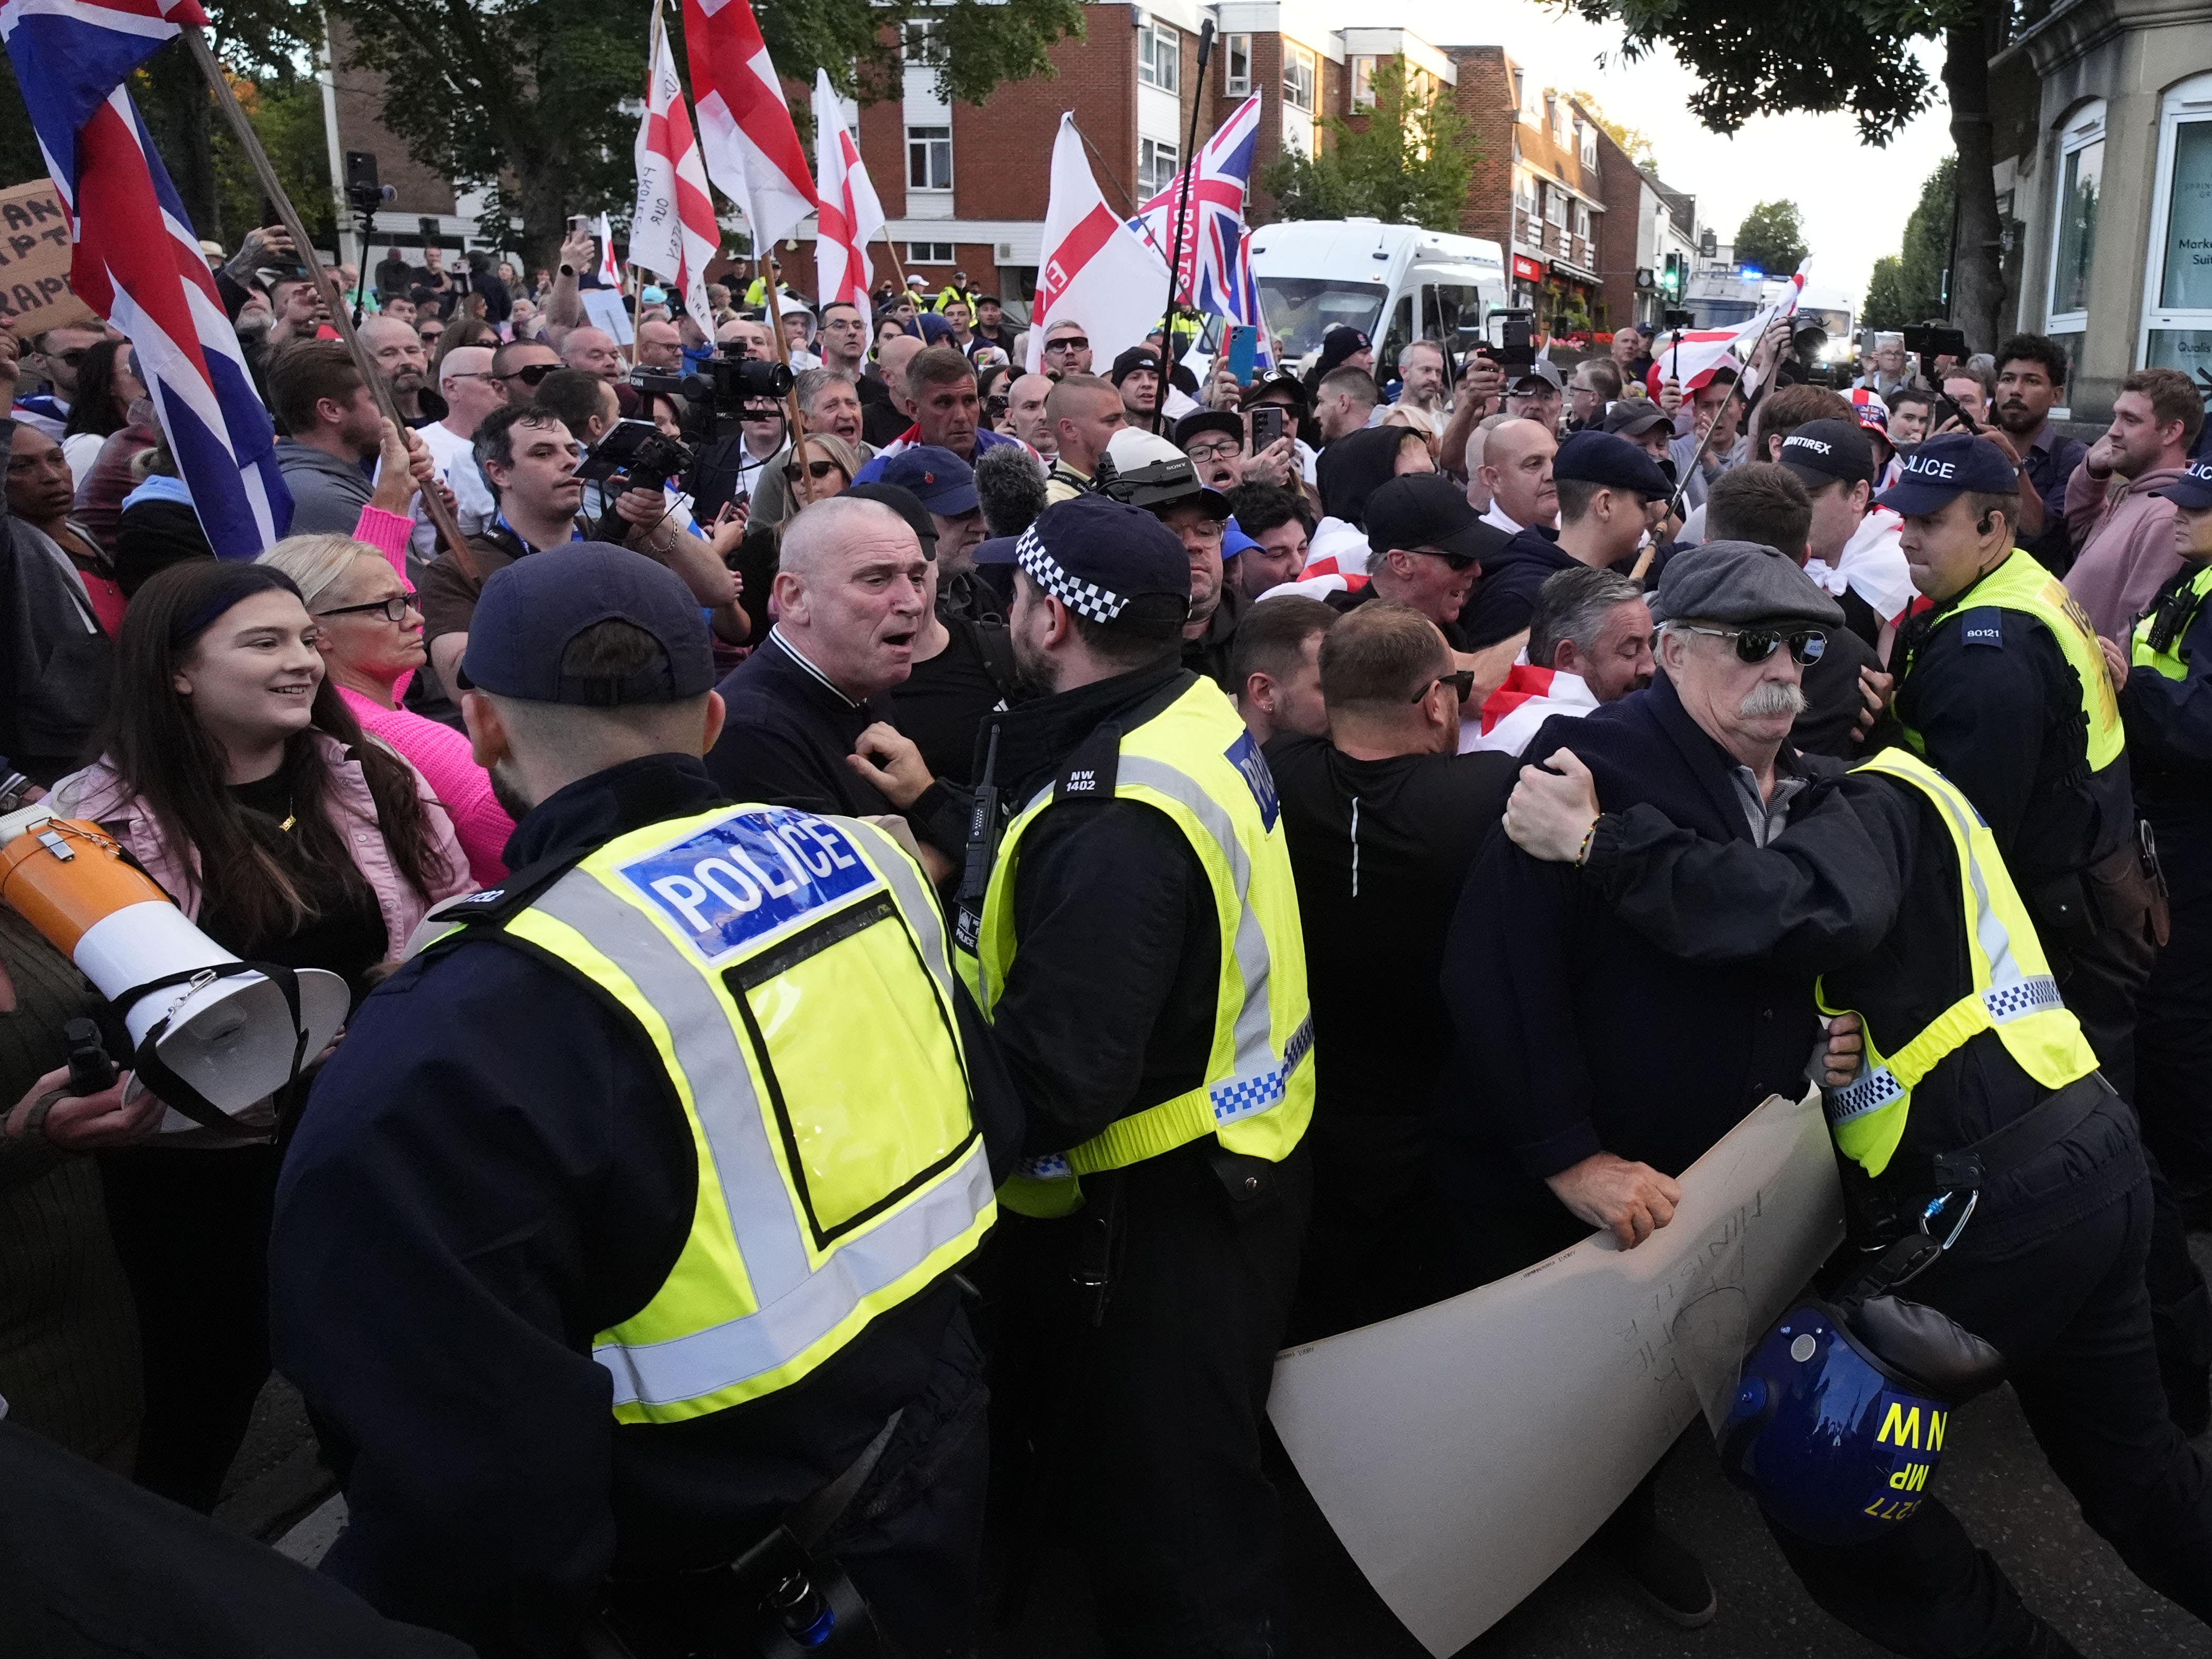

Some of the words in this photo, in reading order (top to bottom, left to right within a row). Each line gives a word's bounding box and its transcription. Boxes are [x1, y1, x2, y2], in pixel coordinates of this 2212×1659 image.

[1173, 209, 1194, 289] BOATS
[1165, 462, 1186, 471] SONY
[1967, 629, 2000, 638] 80121
[1071, 770, 1094, 781] NW
[1066, 780, 1096, 792] 1402
[650, 818, 856, 933] POLICE
[956, 928, 975, 947] POLICE
[1876, 1402, 1948, 1452] NW
[1889, 1462, 1930, 1492] MP
